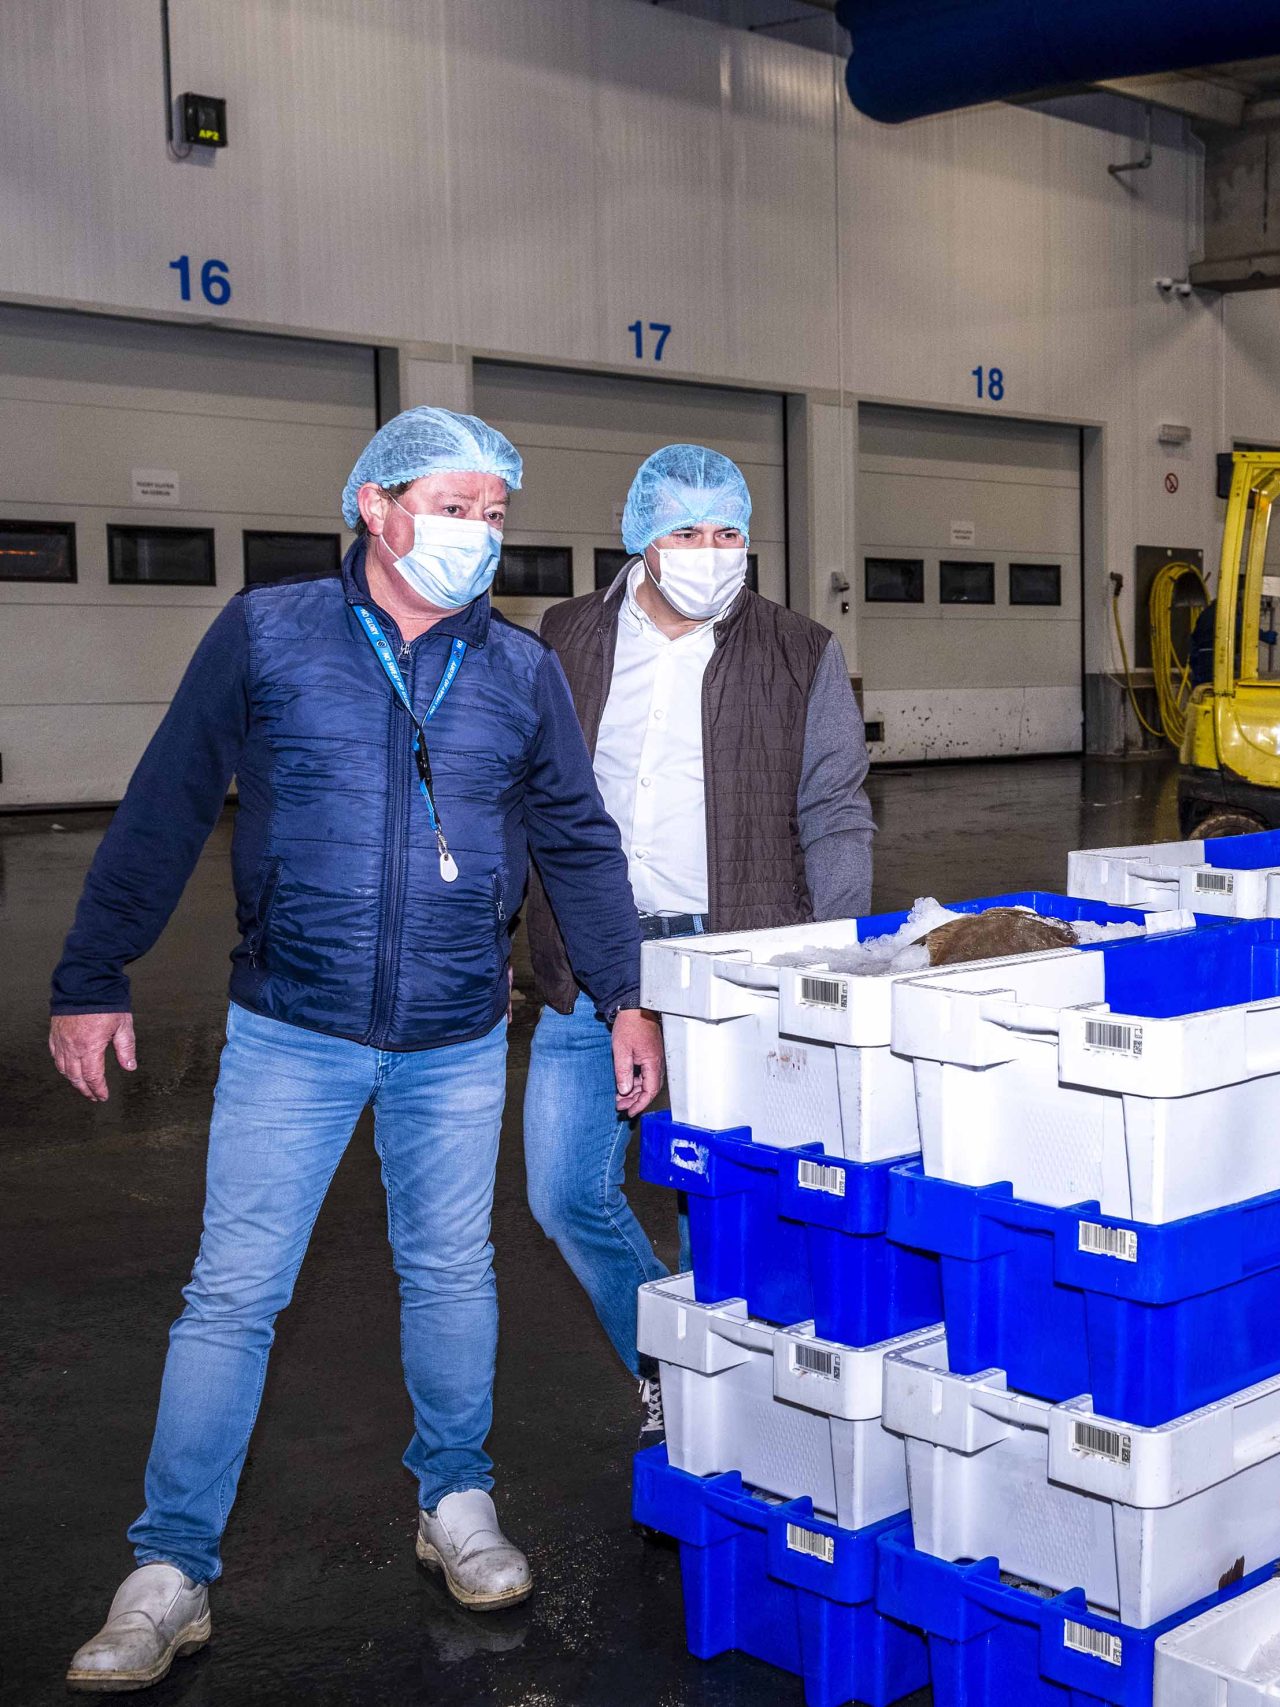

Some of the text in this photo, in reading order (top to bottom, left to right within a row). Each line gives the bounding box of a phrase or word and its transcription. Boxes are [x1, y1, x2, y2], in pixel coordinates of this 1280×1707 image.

[199, 129, 219, 141] AP2
[169, 255, 231, 305] 16
[628, 320, 671, 361] 17
[972, 366, 1004, 401] 18
